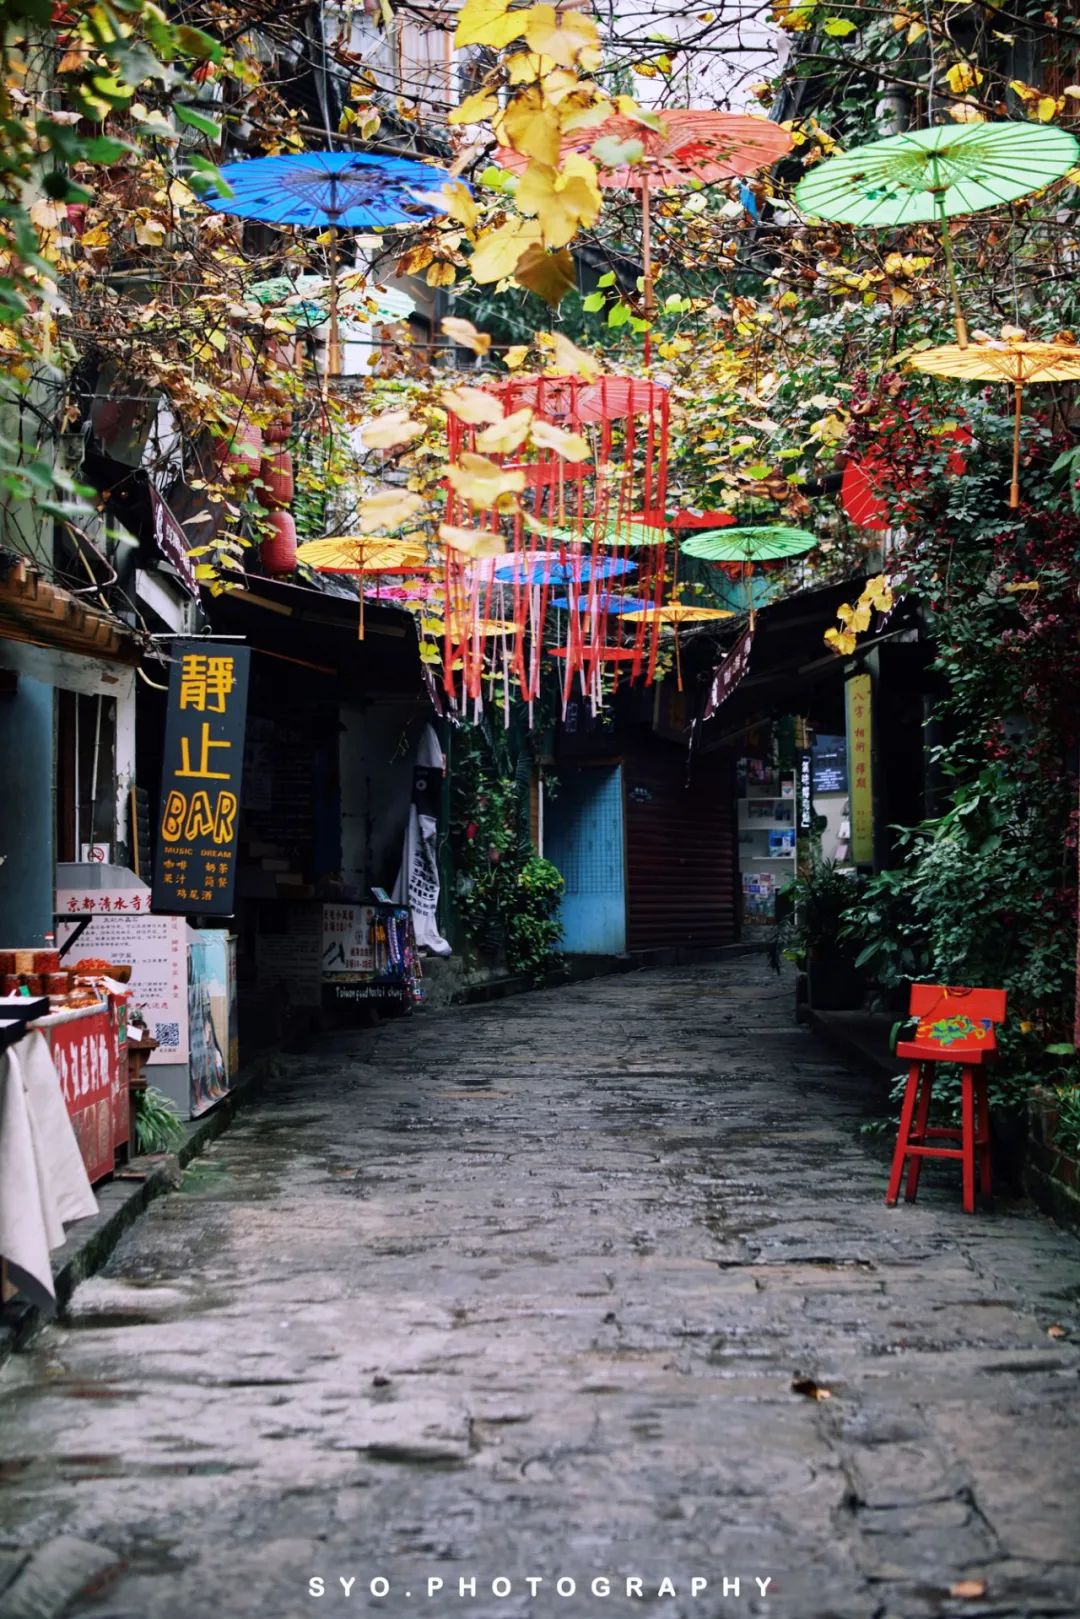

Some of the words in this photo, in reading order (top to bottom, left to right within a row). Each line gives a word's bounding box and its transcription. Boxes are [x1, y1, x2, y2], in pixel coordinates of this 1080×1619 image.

[161, 790, 237, 844] BAR
[164, 846, 193, 856] MUSIC
[200, 849, 232, 859] DREAM
[162, 858, 188, 871] 咖啡
[204, 862, 230, 874] 奶茶
